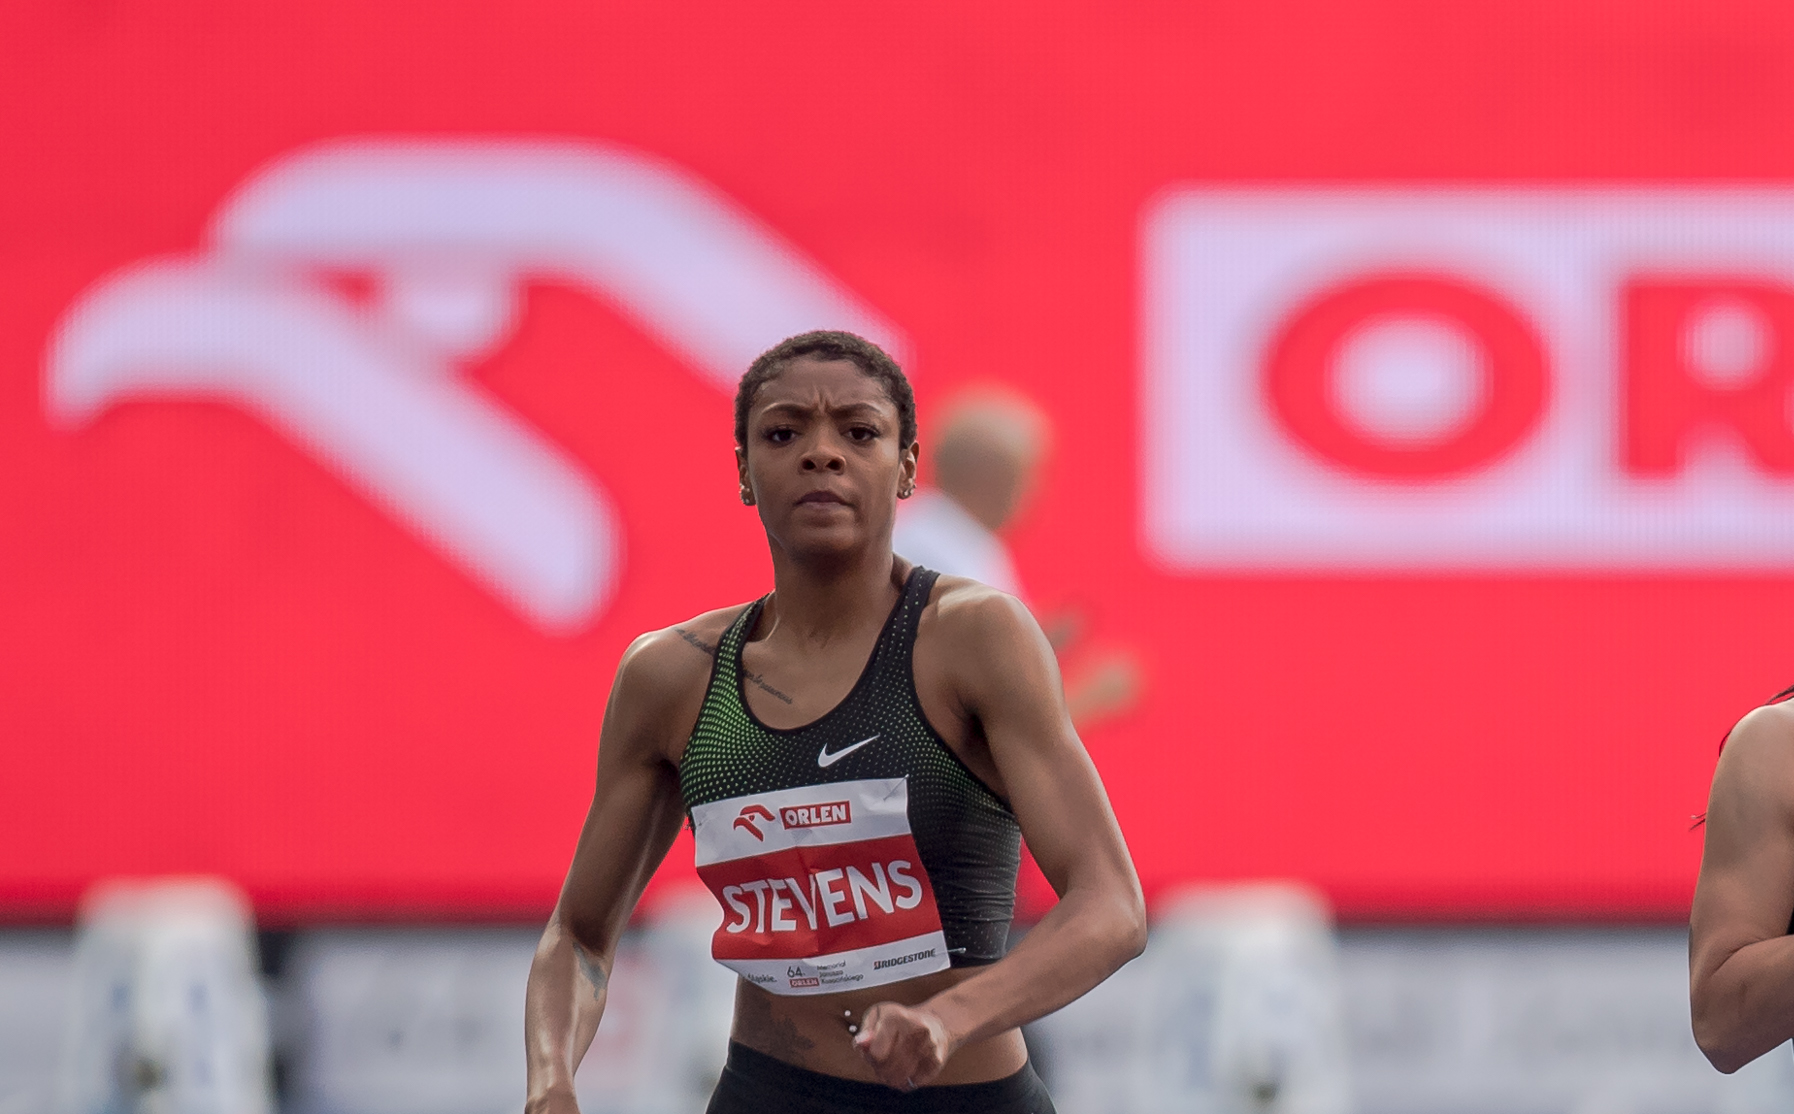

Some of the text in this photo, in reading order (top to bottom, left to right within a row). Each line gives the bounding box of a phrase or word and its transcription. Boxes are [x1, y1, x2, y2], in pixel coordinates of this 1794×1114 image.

[784, 803, 847, 827] ORLEN
[722, 859, 923, 934] STEVENS
[873, 948, 936, 970] BRIDGESTONE
